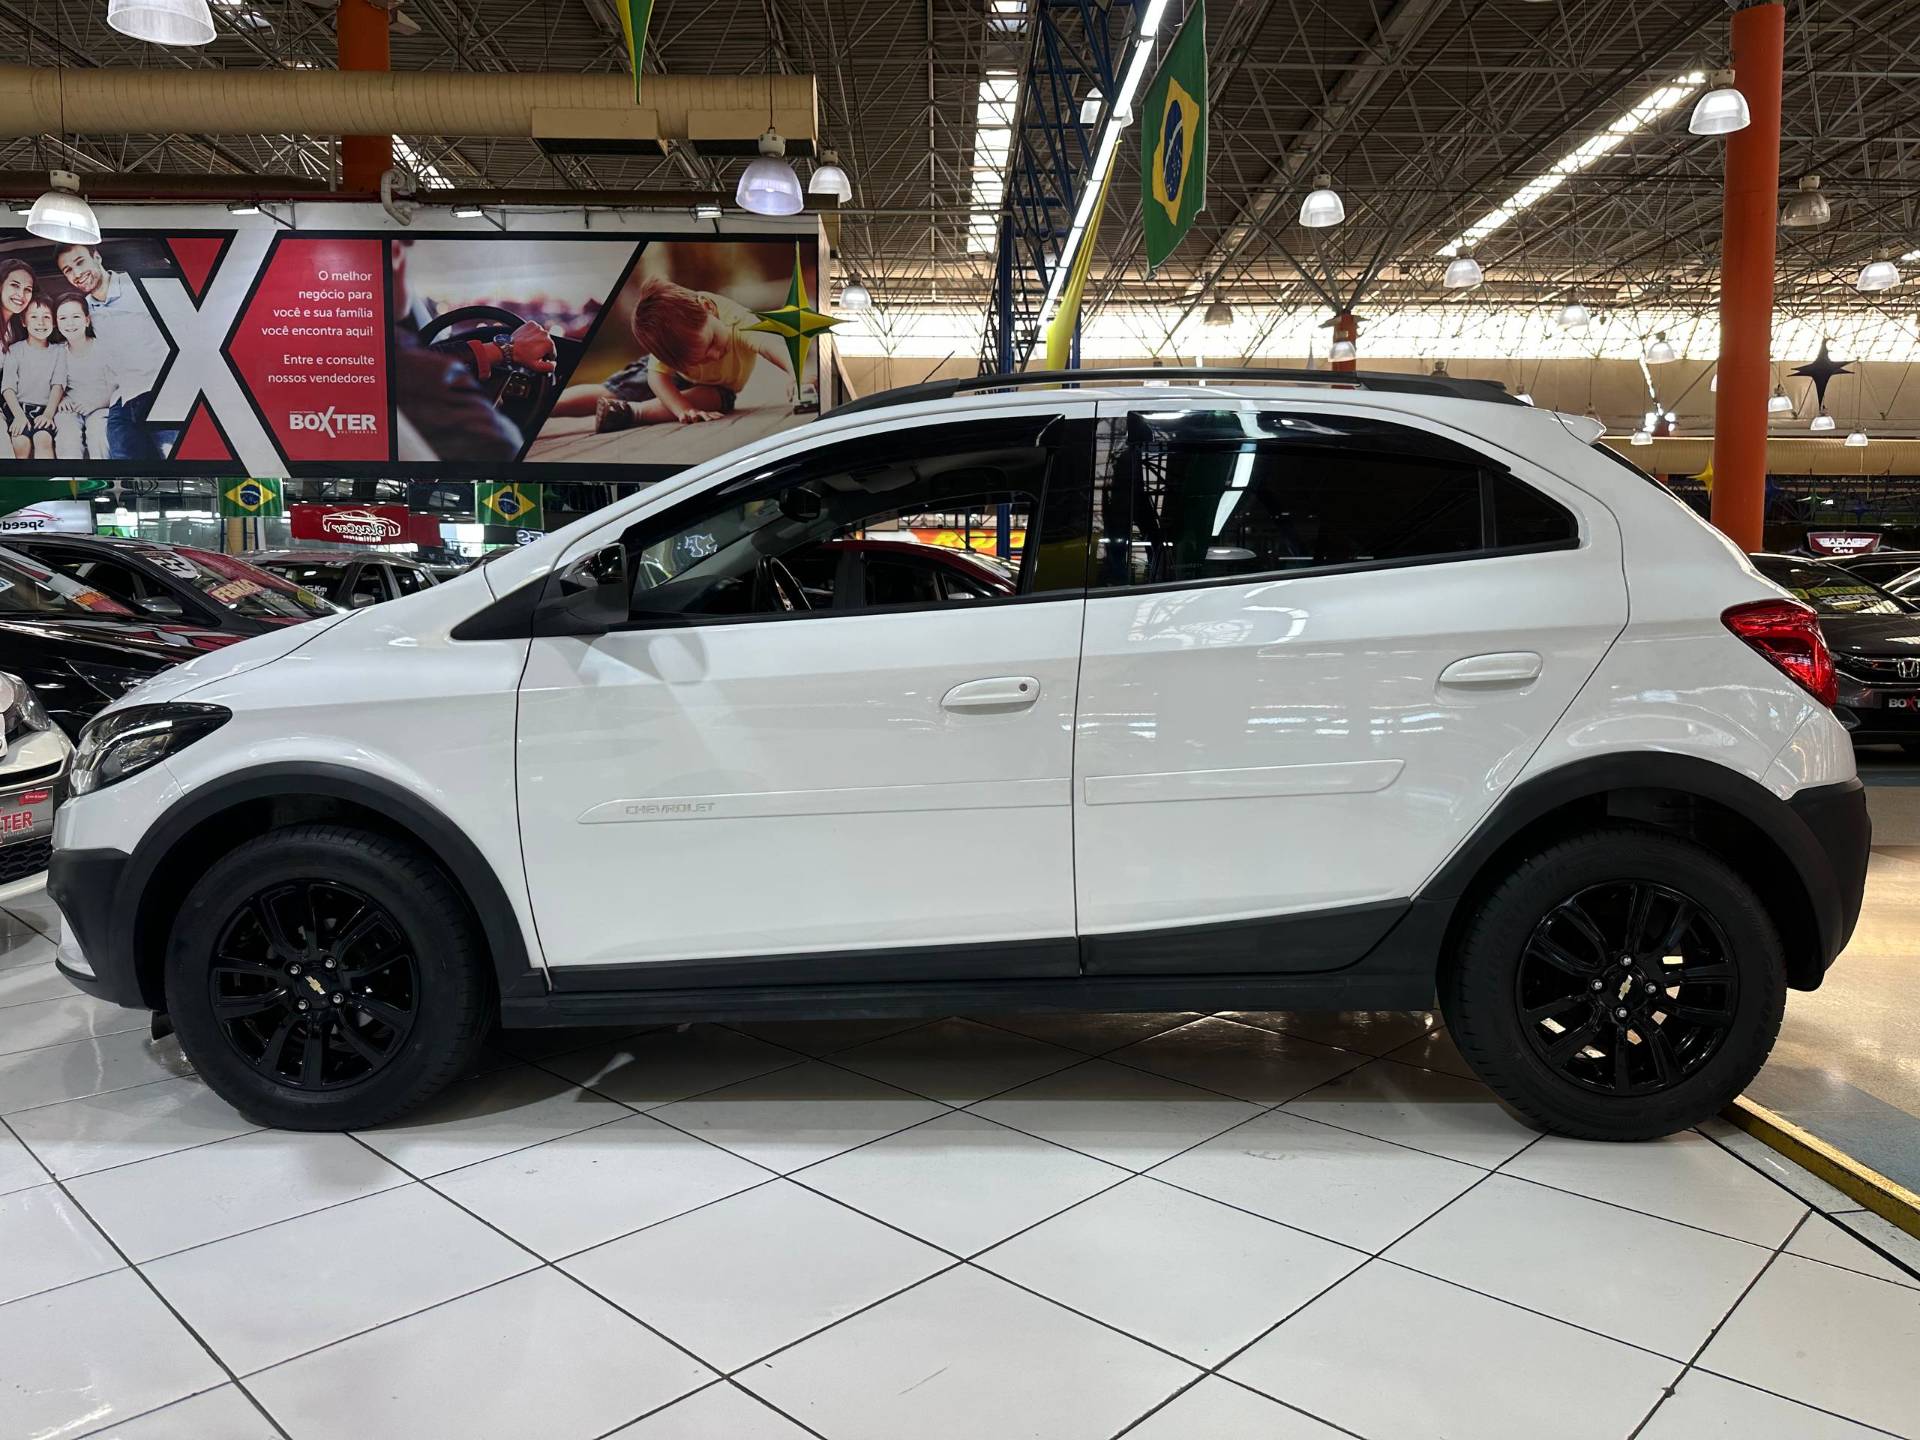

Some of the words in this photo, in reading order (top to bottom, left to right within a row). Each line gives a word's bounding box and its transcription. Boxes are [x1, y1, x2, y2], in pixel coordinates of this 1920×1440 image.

[318, 270, 329, 281] O
[331, 271, 372, 281] melhor
[298, 289, 345, 301] negócio
[348, 290, 372, 301] para
[273, 307, 301, 317] você
[303, 309, 311, 317] e
[313, 309, 333, 317] sua
[336, 307, 373, 318] família
[261, 325, 289, 335] você
[291, 326, 343, 336] encontra
[345, 326, 374, 338] aqui!
[283, 354, 314, 365] Entre
[316, 357, 323, 365] e
[326, 355, 375, 365] consulte
[268, 374, 307, 383] nossos
[309, 373, 376, 384] vendedores
[289, 405, 377, 439] BOXTER
[625, 803, 715, 815] CHEVROLET
